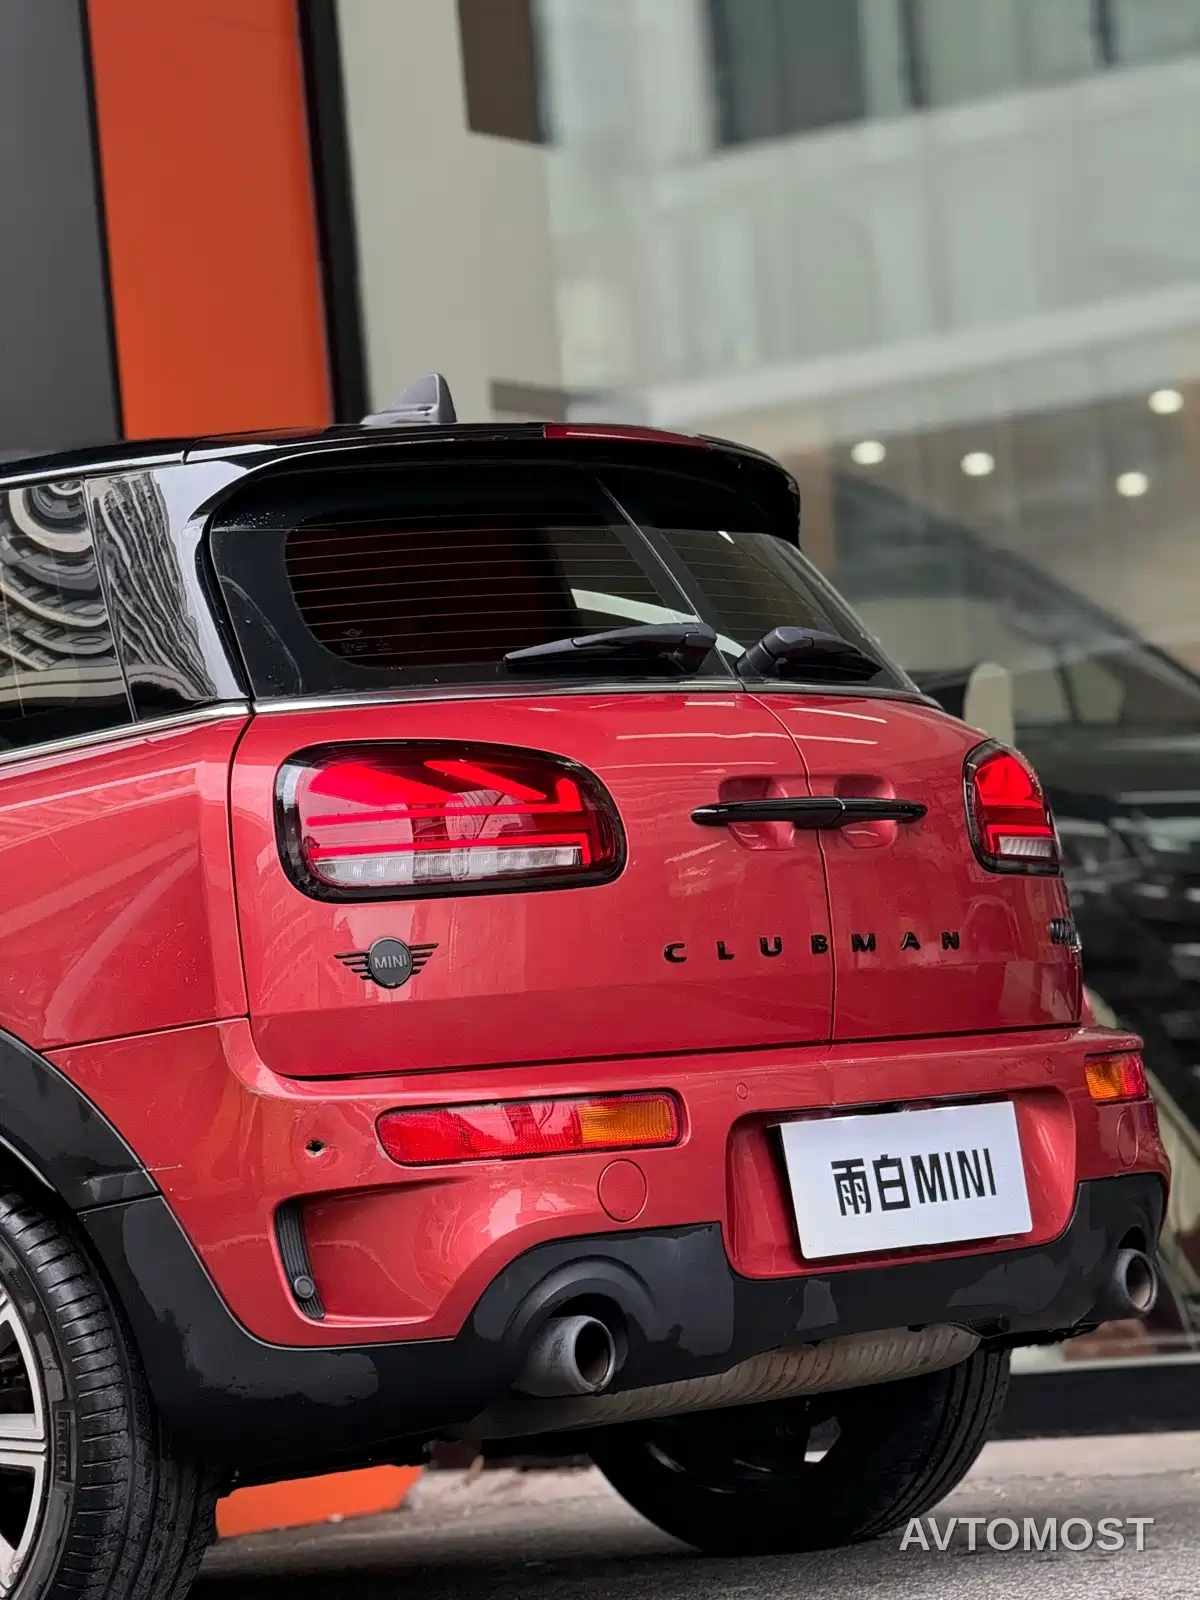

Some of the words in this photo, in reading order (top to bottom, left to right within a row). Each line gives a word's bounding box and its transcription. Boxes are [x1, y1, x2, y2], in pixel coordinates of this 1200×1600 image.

[374, 954, 407, 970] MINI
[664, 931, 960, 963] CLUBMAN
[830, 1148, 997, 1217] 雨白MINI
